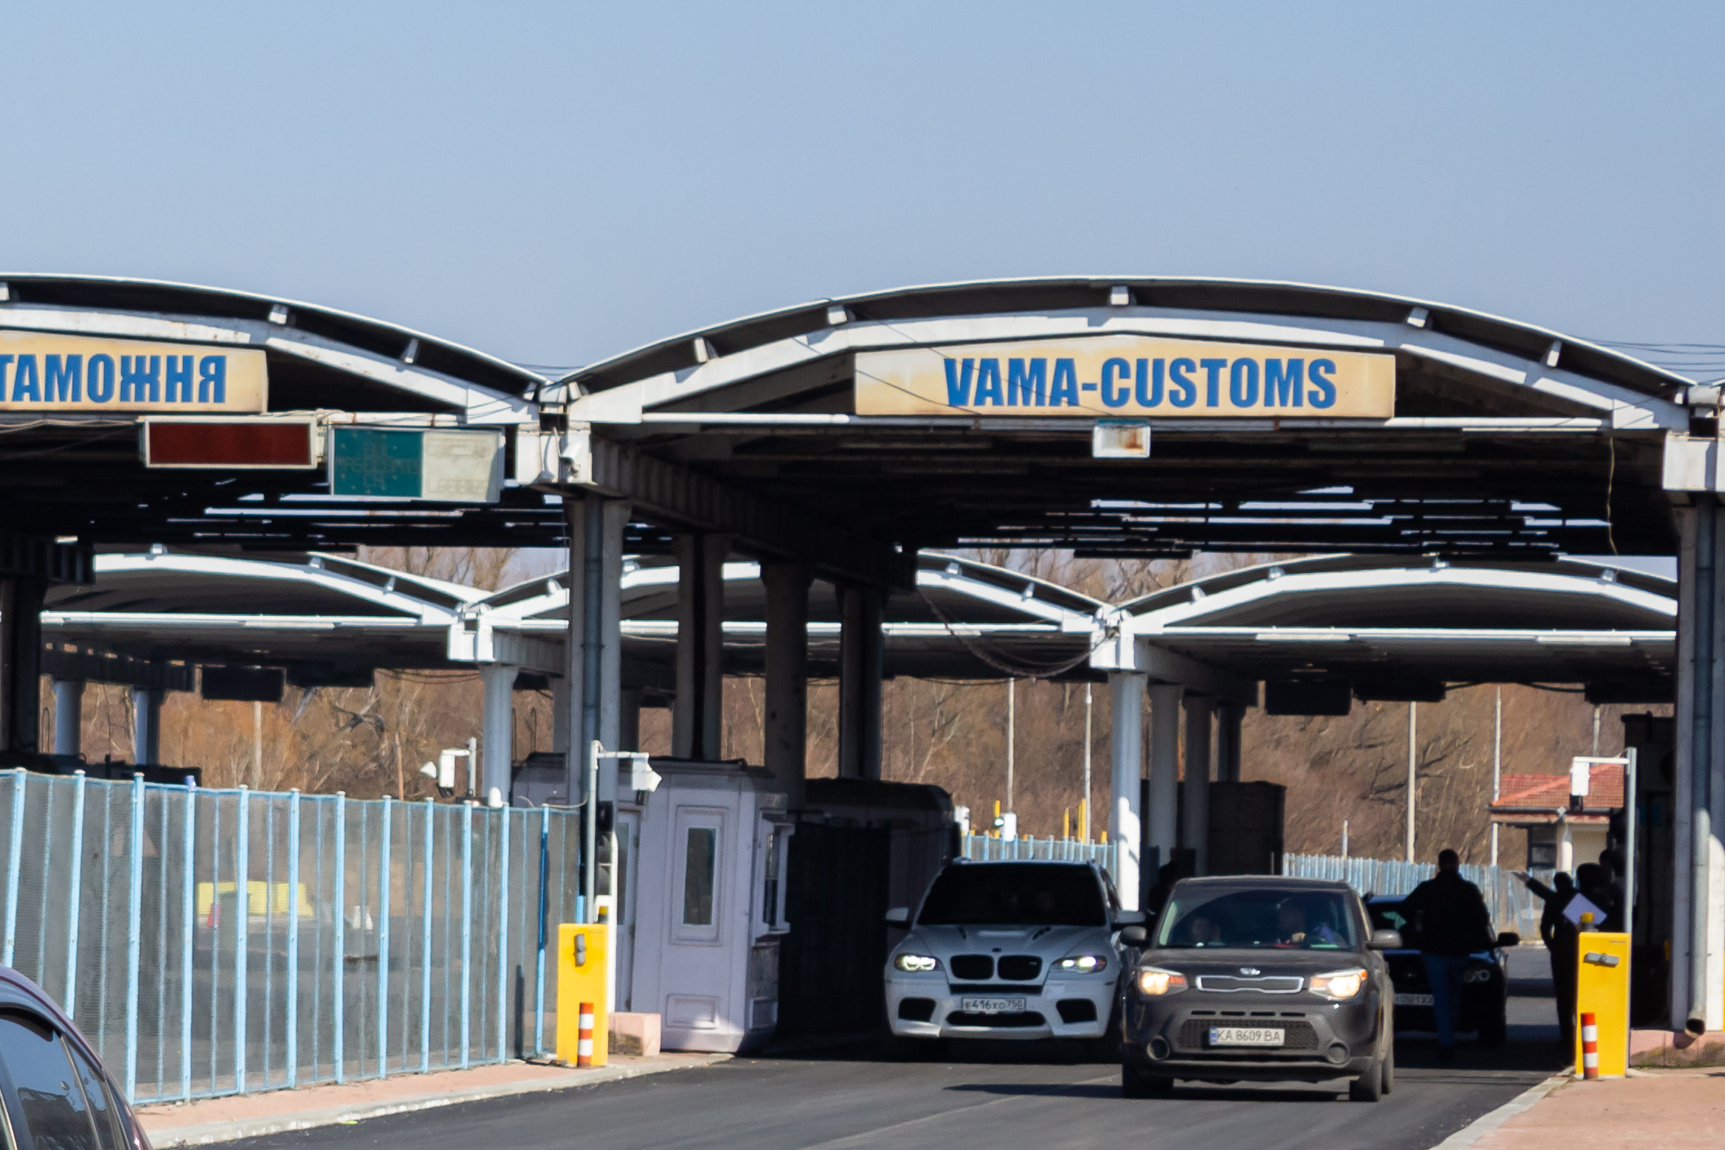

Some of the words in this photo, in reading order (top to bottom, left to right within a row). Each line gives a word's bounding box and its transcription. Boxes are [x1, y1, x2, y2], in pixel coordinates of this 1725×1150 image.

[944, 357, 1336, 409] VAMA-CUSTOMS
[1217, 1030, 1233, 1041] KA
[1236, 1030, 1262, 1041] 8609
[1264, 1030, 1281, 1042] BA
